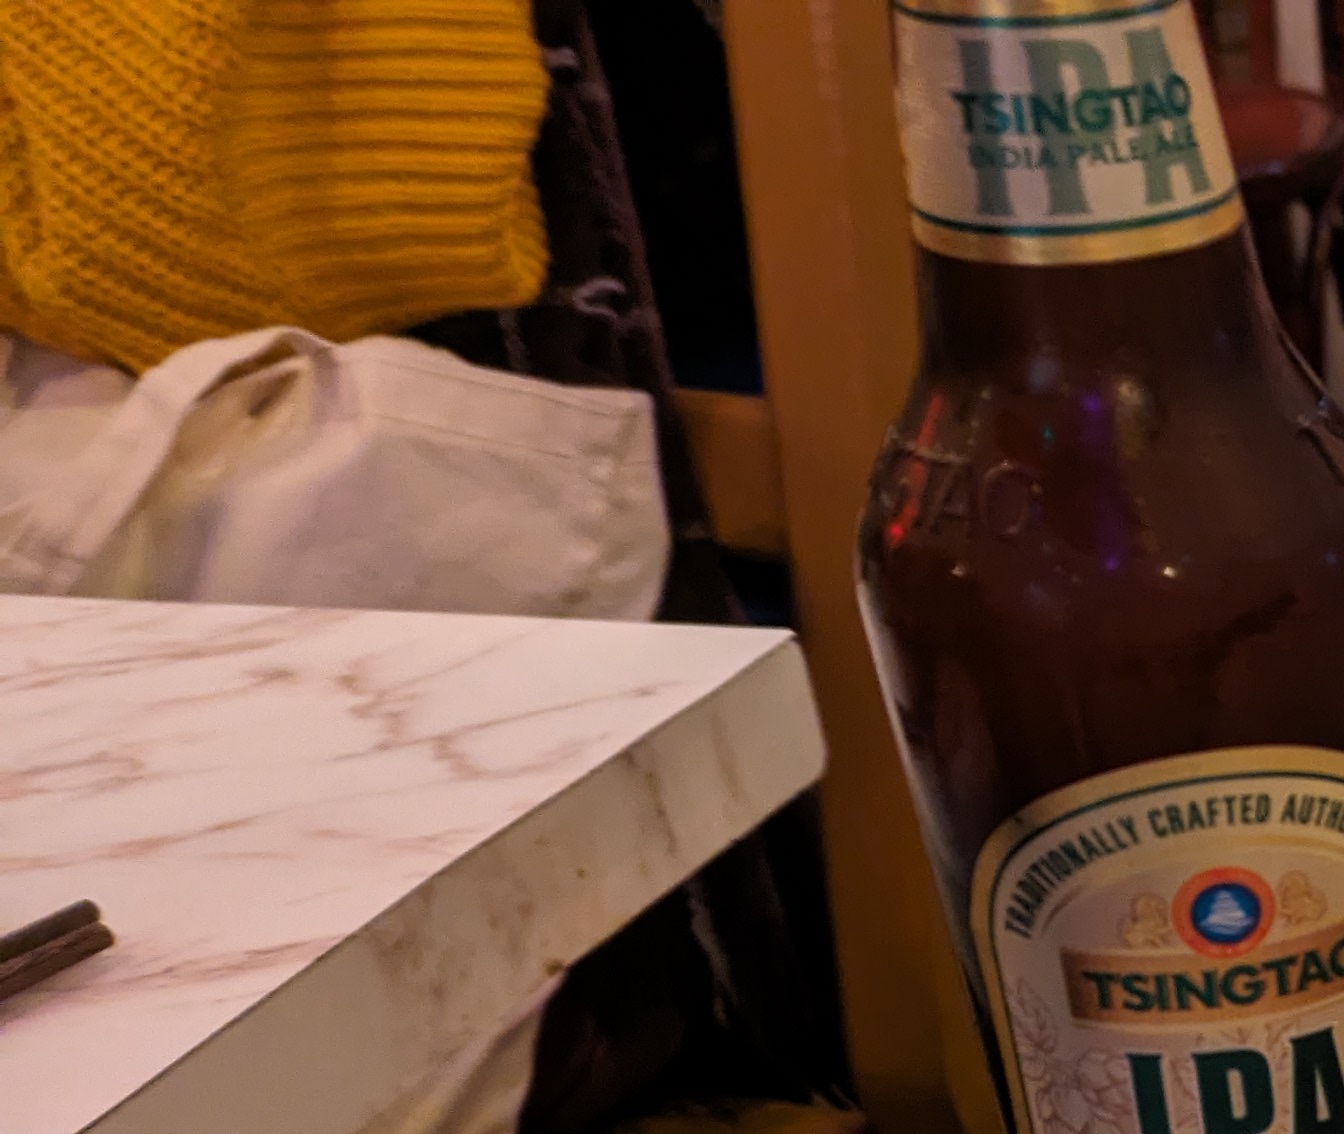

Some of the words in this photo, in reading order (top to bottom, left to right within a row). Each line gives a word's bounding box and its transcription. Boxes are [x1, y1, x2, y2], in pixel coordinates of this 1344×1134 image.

[953, 73, 1190, 134] TSINGTAO
[957, 26, 1211, 217] IPA
[968, 144, 1056, 171] INDIA
[1067, 139, 1147, 164] PALE
[1157, 130, 1198, 153] ALE
[1004, 816, 1139, 939] TRADITIONALLY
[1148, 793, 1271, 838] CRAFTED
